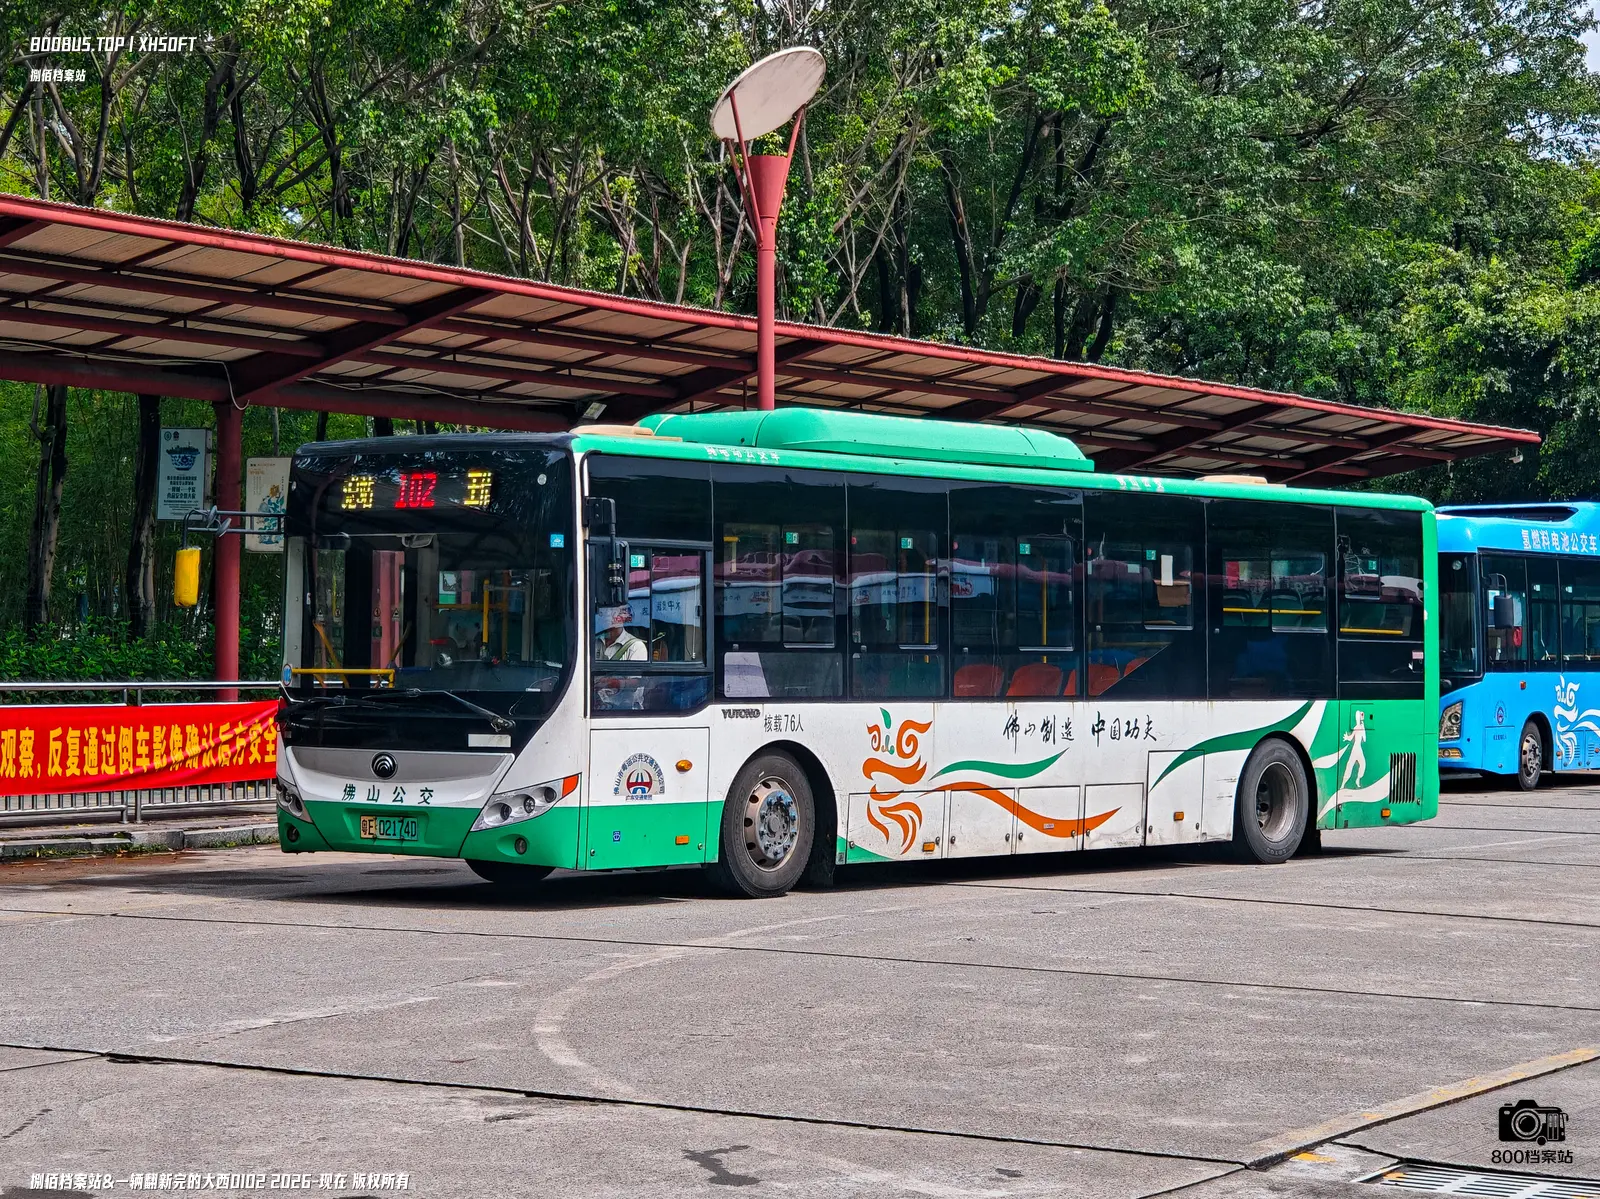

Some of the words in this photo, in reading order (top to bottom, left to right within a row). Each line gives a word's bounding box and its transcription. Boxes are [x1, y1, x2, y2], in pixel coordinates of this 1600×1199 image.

[395, 473, 437, 509] 102
[1521, 528, 1598, 554] 氢燃料电池公交车
[721, 708, 760, 719] YUTONG
[764, 713, 804, 732] 核载76人
[1003, 709, 1074, 754] 佛山制造
[1092, 711, 1157, 747] 中国功夫
[342, 783, 434, 804] 佛山公交
